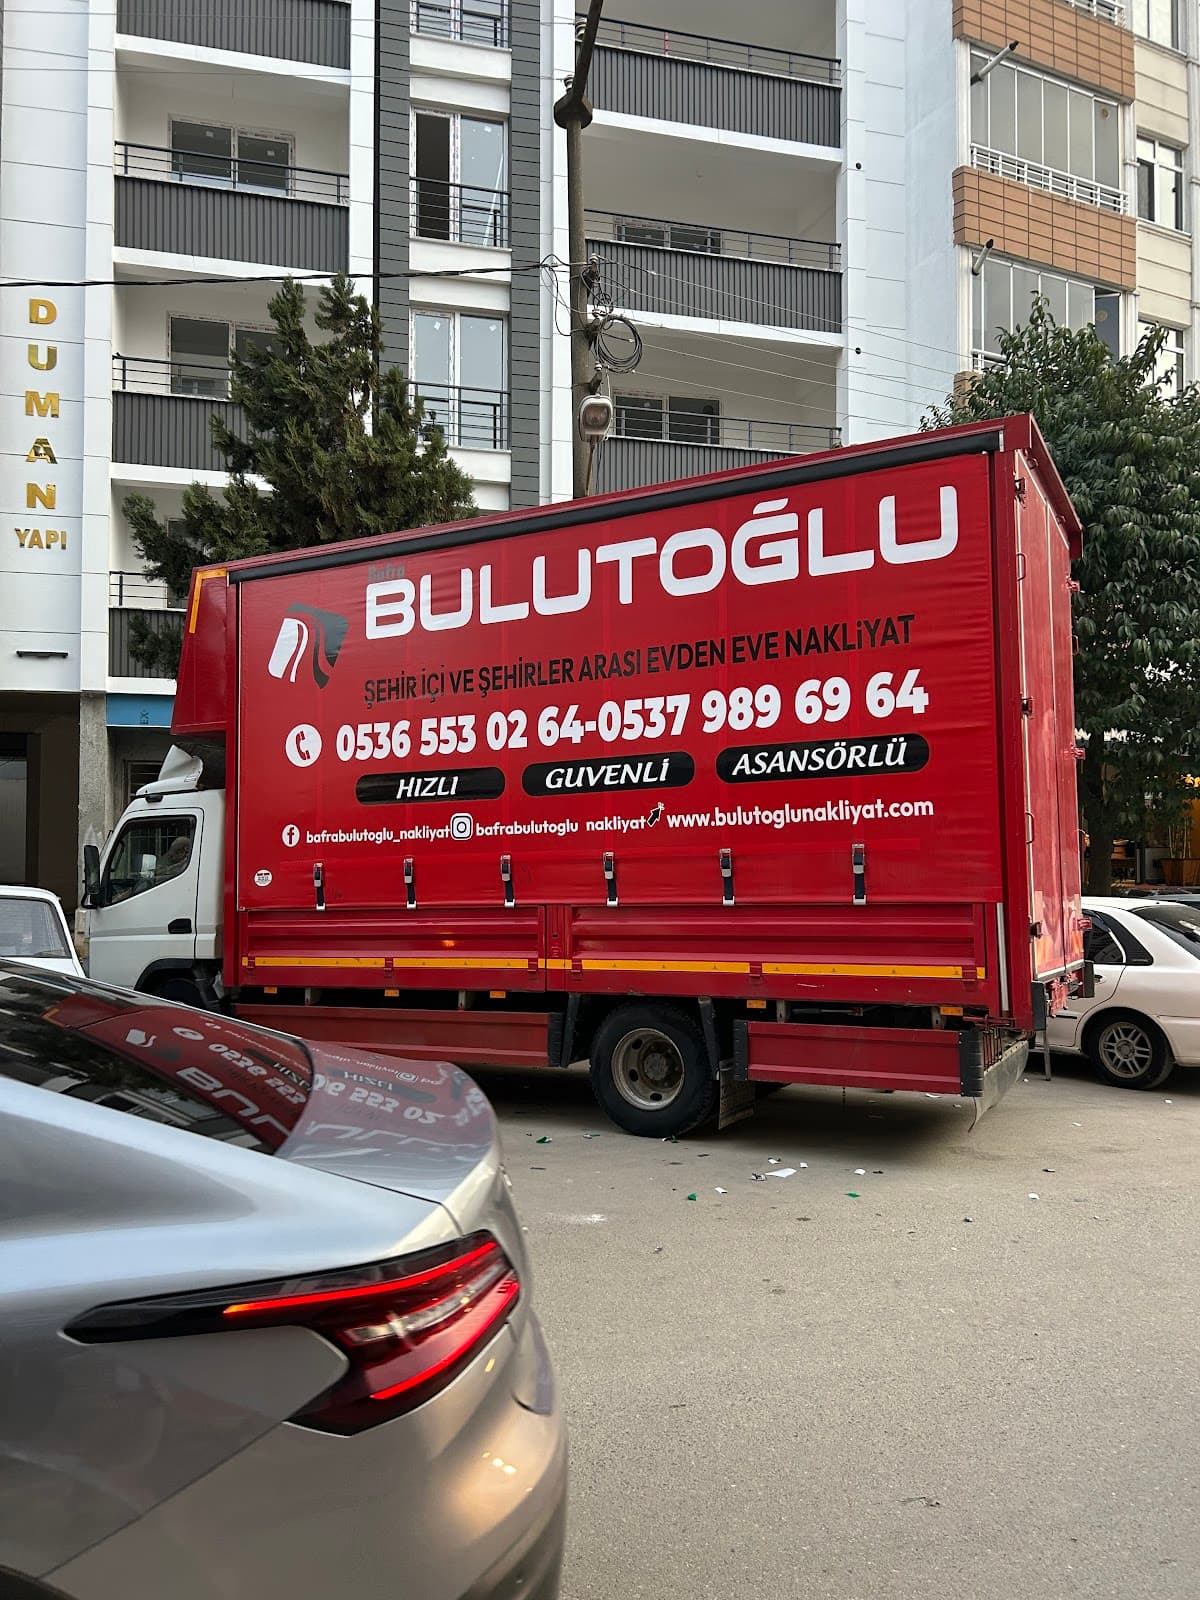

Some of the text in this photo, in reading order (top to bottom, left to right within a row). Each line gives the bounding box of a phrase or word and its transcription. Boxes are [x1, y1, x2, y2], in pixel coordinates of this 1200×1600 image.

[25, 298, 59, 509] DUMAN
[15, 528, 67, 550] YAPI
[366, 486, 959, 640] BULUTOĞLU
[364, 670, 417, 709] ŞEHİR
[422, 664, 445, 703] İÇİ
[449, 669, 474, 694] VE
[478, 657, 574, 697] ŞEHİRLER
[578, 649, 641, 681] ARASI
[647, 638, 725, 673] EVDEN
[732, 631, 778, 664] EVE
[336, 720, 411, 761] 0536
[419, 714, 476, 756] 553
[486, 709, 528, 751] 02
[701, 684, 781, 733] 989
[795, 676, 851, 724] 69
[866, 669, 929, 718] 64
[732, 737, 908, 776] ASANSÖRLÜ
[396, 775, 459, 799] HIZLI
[545, 757, 670, 789] GUVENLİ
[476, 815, 646, 837] bafrabulutoglu nakliyat
[666, 798, 934, 829] www.bulutoglunakliyat.com
[306, 825, 451, 844] bafrabulutoglu_nakliyat
